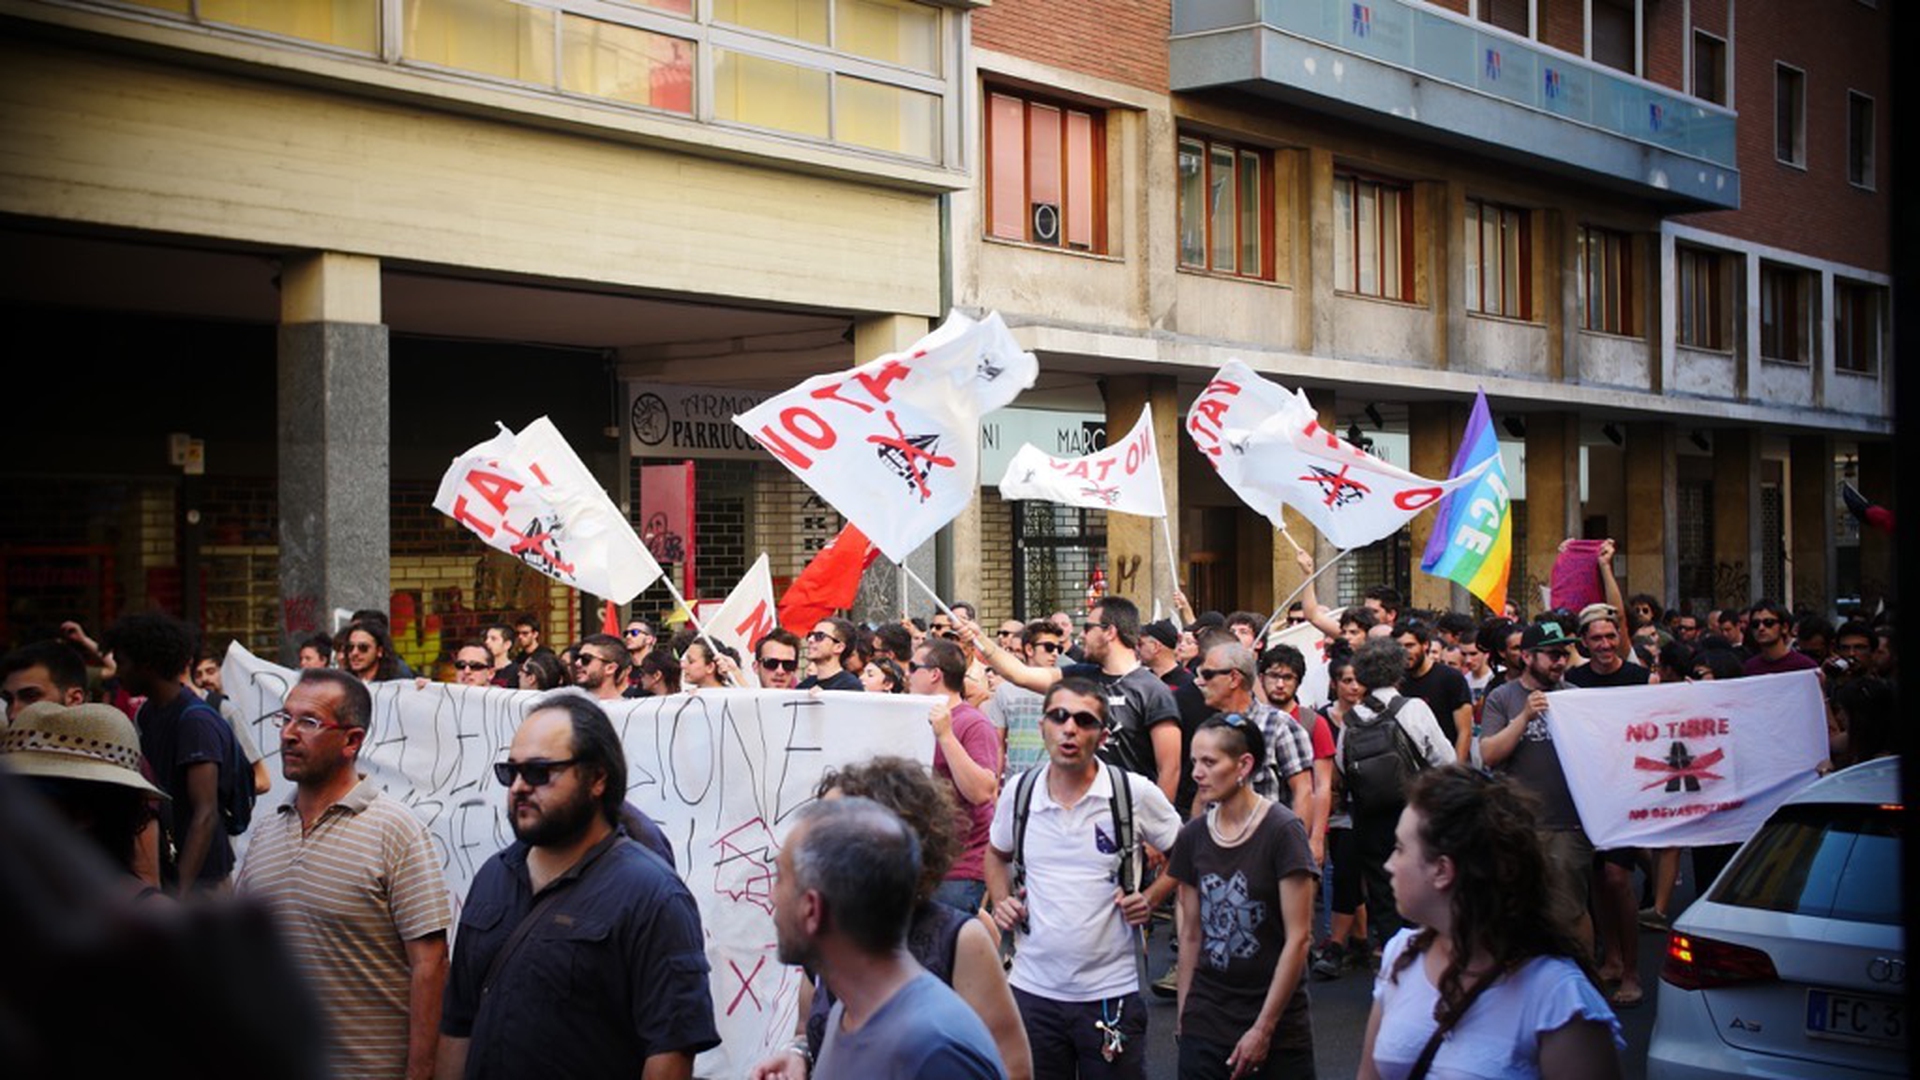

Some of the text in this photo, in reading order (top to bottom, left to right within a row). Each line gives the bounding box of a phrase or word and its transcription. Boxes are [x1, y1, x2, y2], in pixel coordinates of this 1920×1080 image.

[682, 394, 765, 418] ARMO
[753, 350, 928, 470] NO TA
[672, 421, 767, 450] PARRUCC
[1626, 721, 1659, 743] NO
[1729, 1017, 1763, 1033] A3
[1830, 999, 1868, 1033] FC
